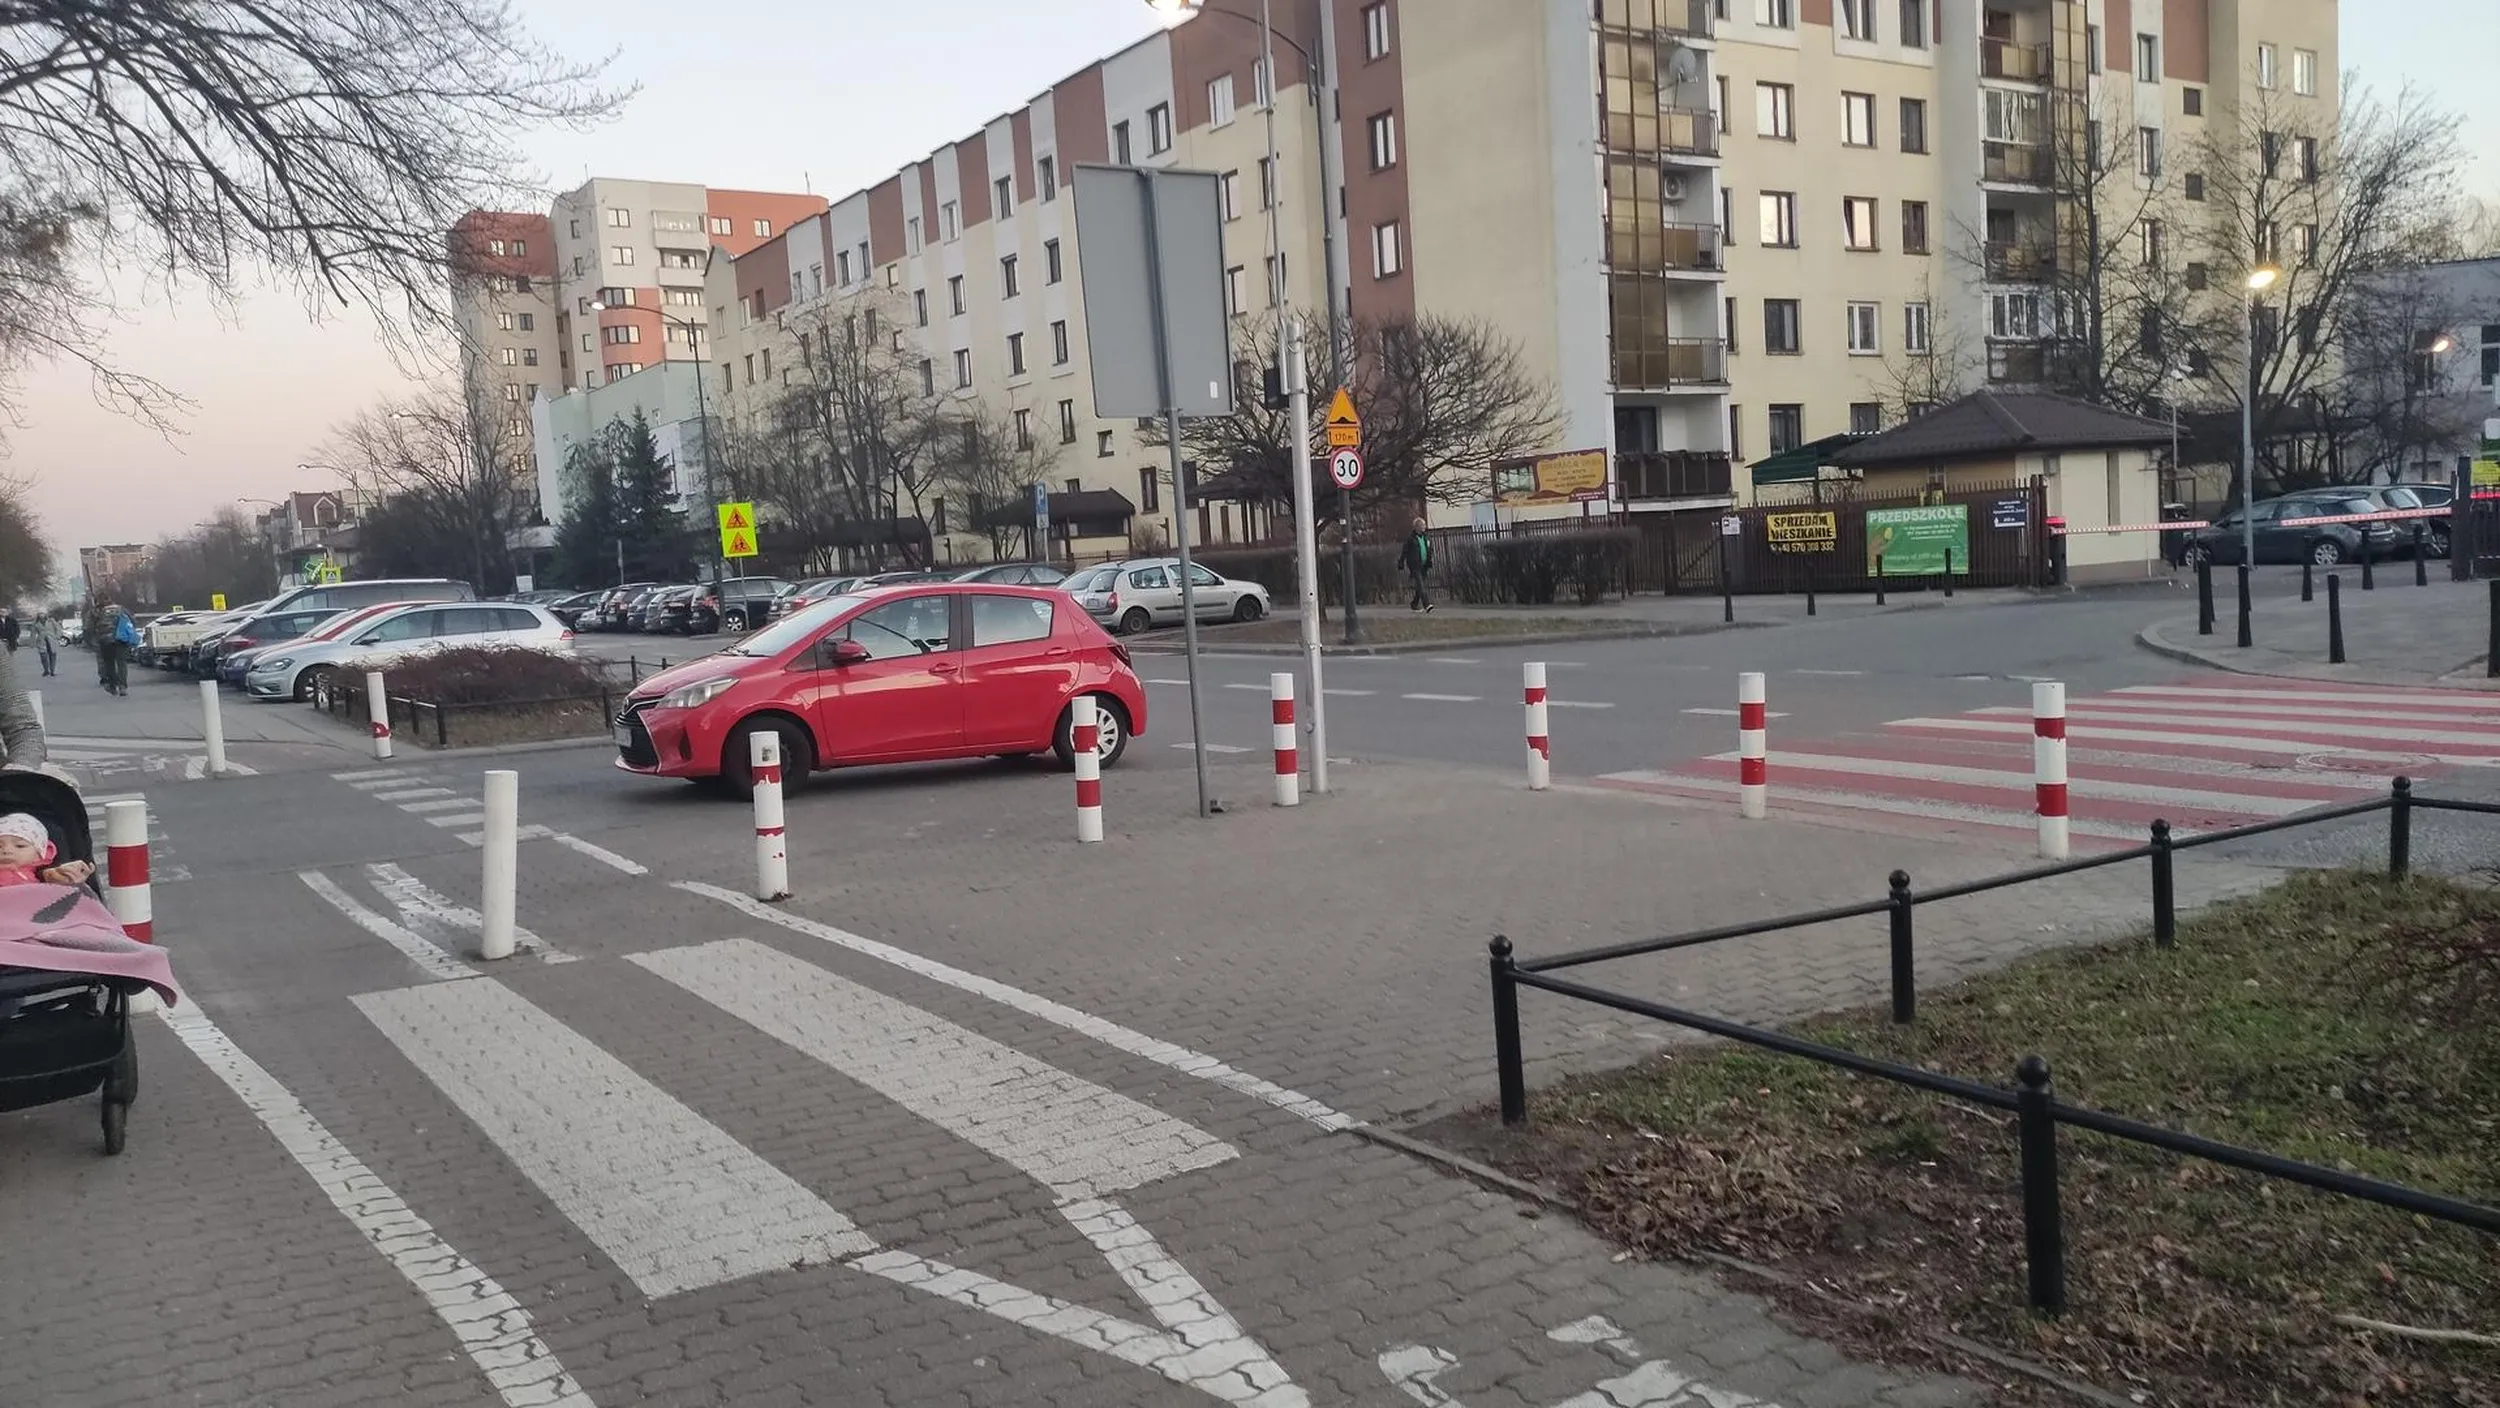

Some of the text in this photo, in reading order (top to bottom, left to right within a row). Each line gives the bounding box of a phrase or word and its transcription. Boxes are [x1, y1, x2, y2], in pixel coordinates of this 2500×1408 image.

[1336, 459, 1358, 477] 30
[1773, 514, 1829, 528] SPRZEDAM
[1869, 507, 1965, 523] PRZEDSZKOLE
[1770, 527, 1833, 539] MIESZKANIE
[1791, 542, 1806, 552] 570
